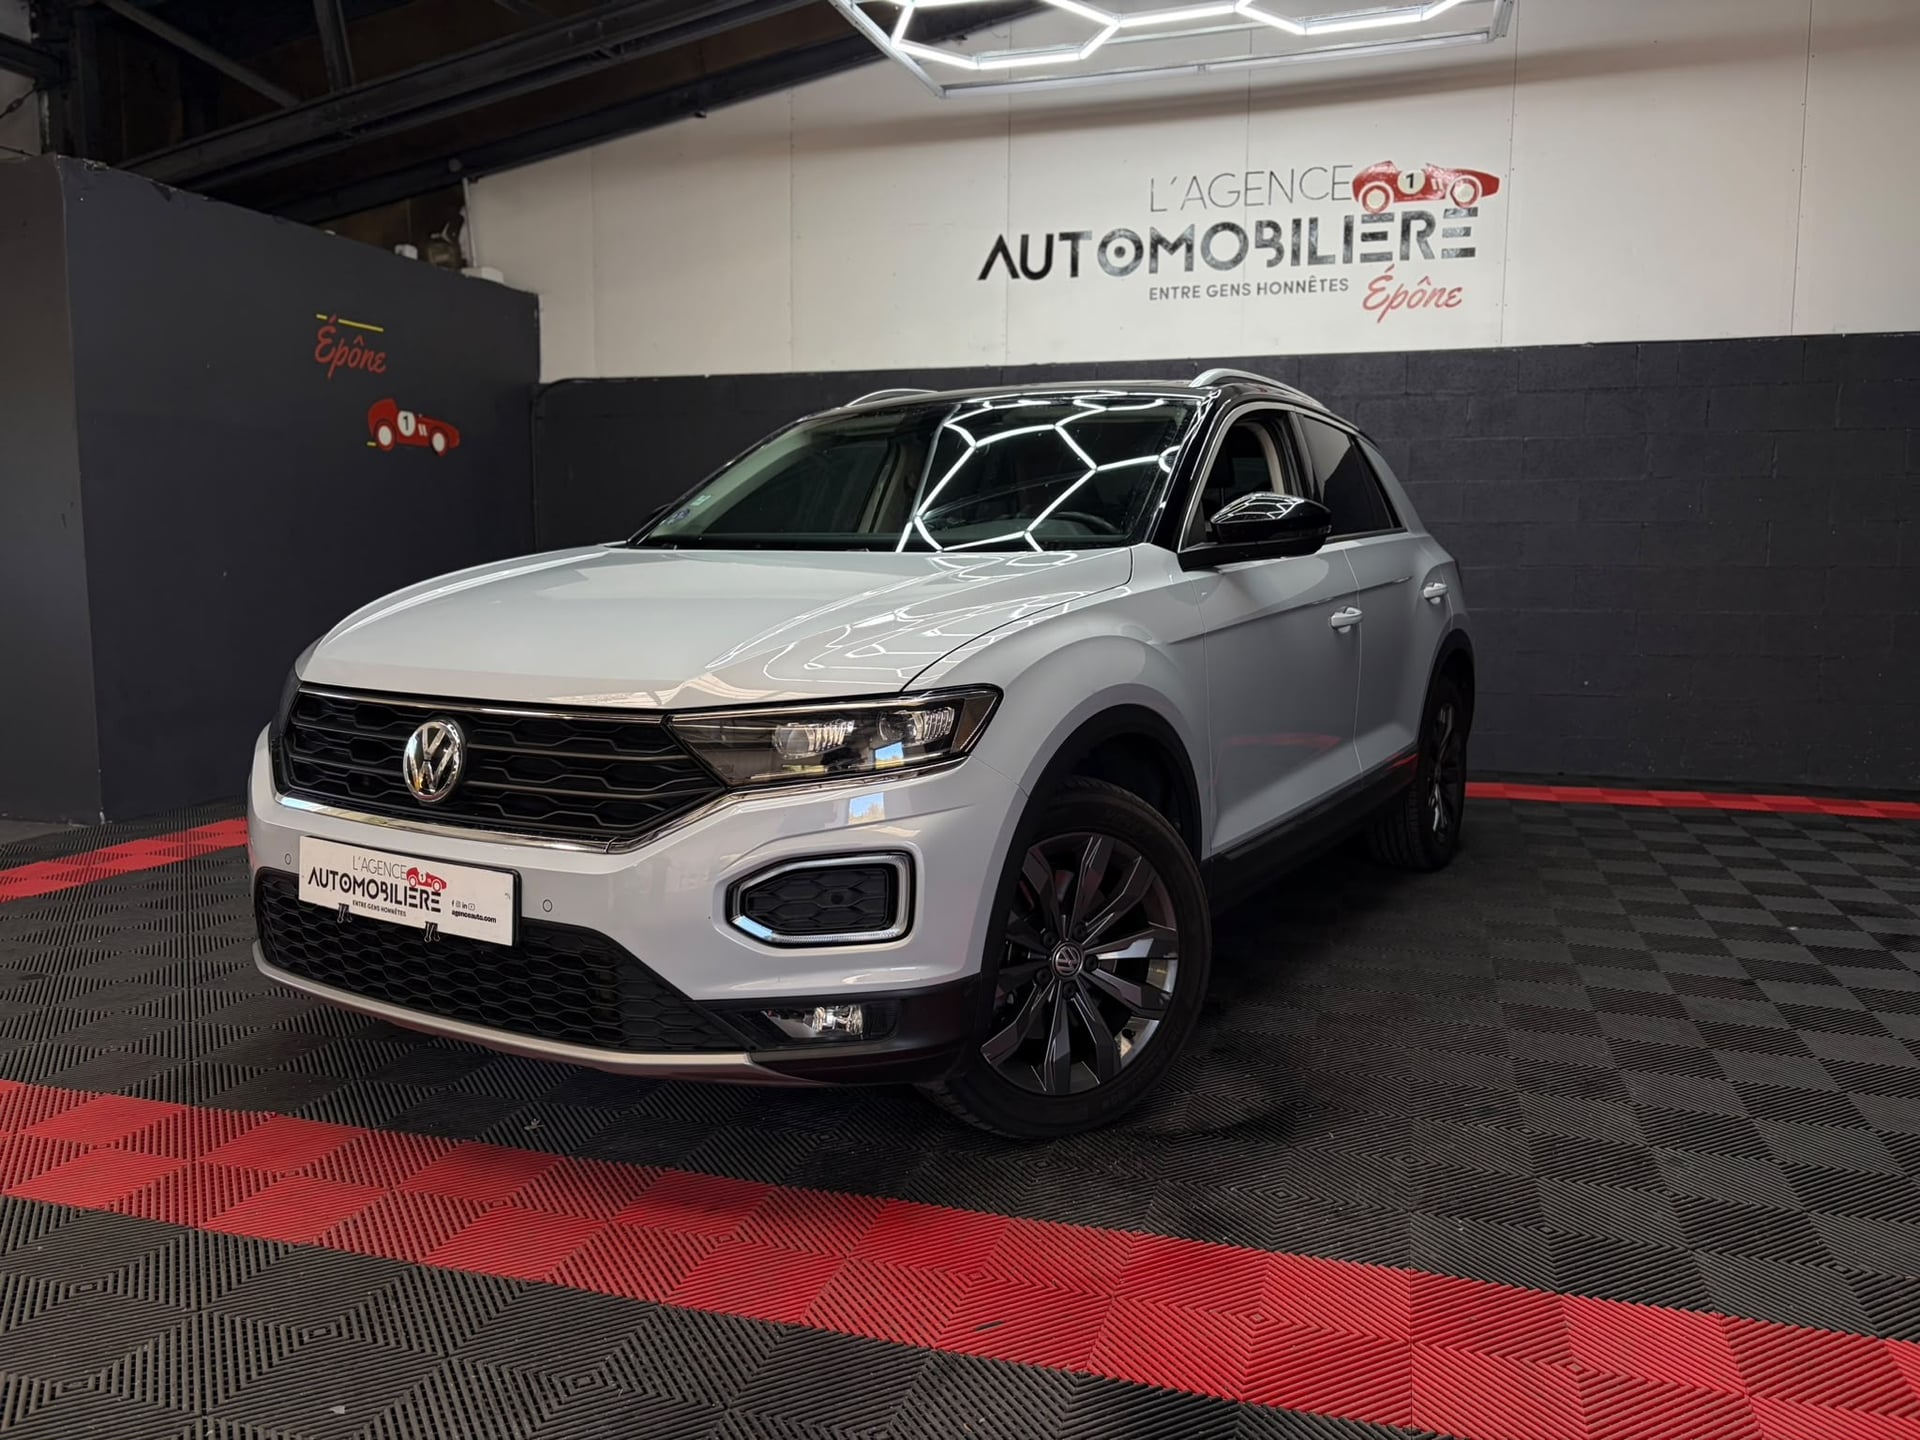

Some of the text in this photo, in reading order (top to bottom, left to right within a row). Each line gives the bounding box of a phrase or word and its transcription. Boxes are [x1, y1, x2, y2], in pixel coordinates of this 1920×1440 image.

[1149, 165, 1354, 213] L'AGENCE
[1149, 275, 1349, 300] ENTRE GENS HONNÊTES
[1361, 264, 1463, 323] Épône
[314, 314, 387, 379] Épône
[352, 856, 407, 880] L'AGENCE
[352, 900, 367, 909] ENTRE
[367, 903, 381, 912] GENS
